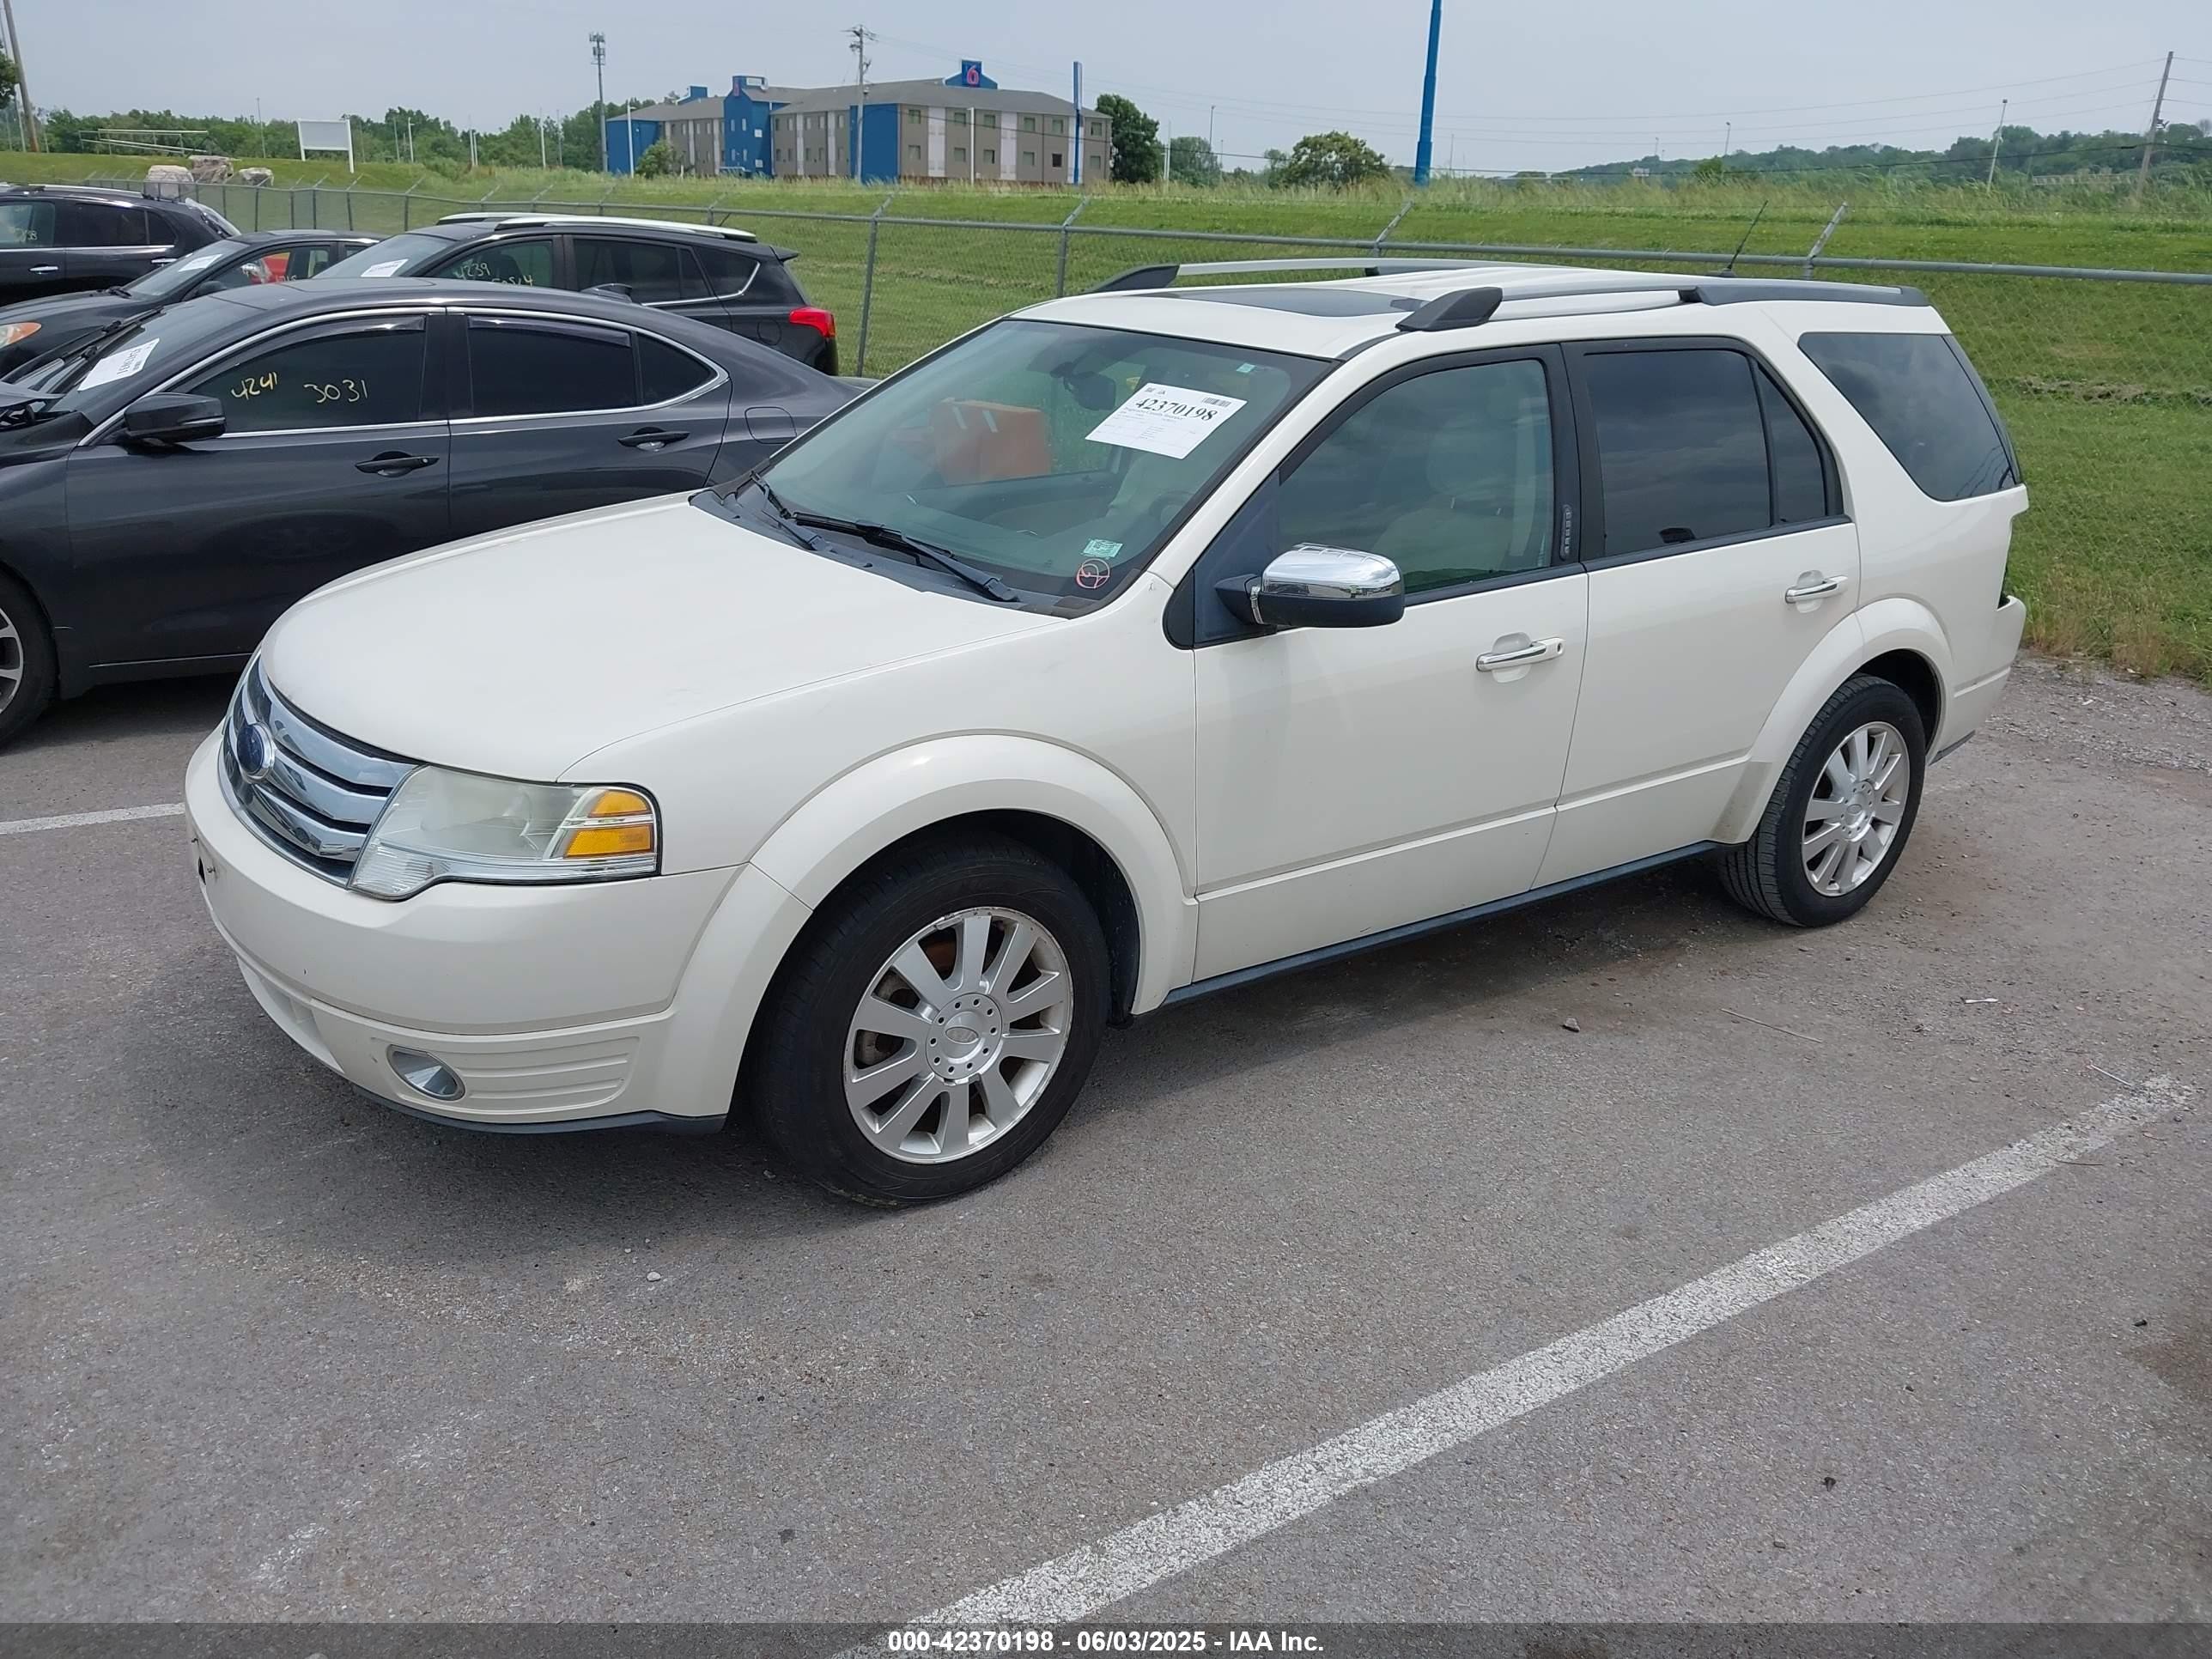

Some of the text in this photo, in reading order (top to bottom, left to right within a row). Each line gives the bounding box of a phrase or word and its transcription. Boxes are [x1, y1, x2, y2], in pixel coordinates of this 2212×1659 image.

[967, 65, 979, 84] 6
[454, 263, 490, 280] 4239
[231, 372, 368, 403] 4241 3031
[1136, 398, 1218, 422] 42370198
